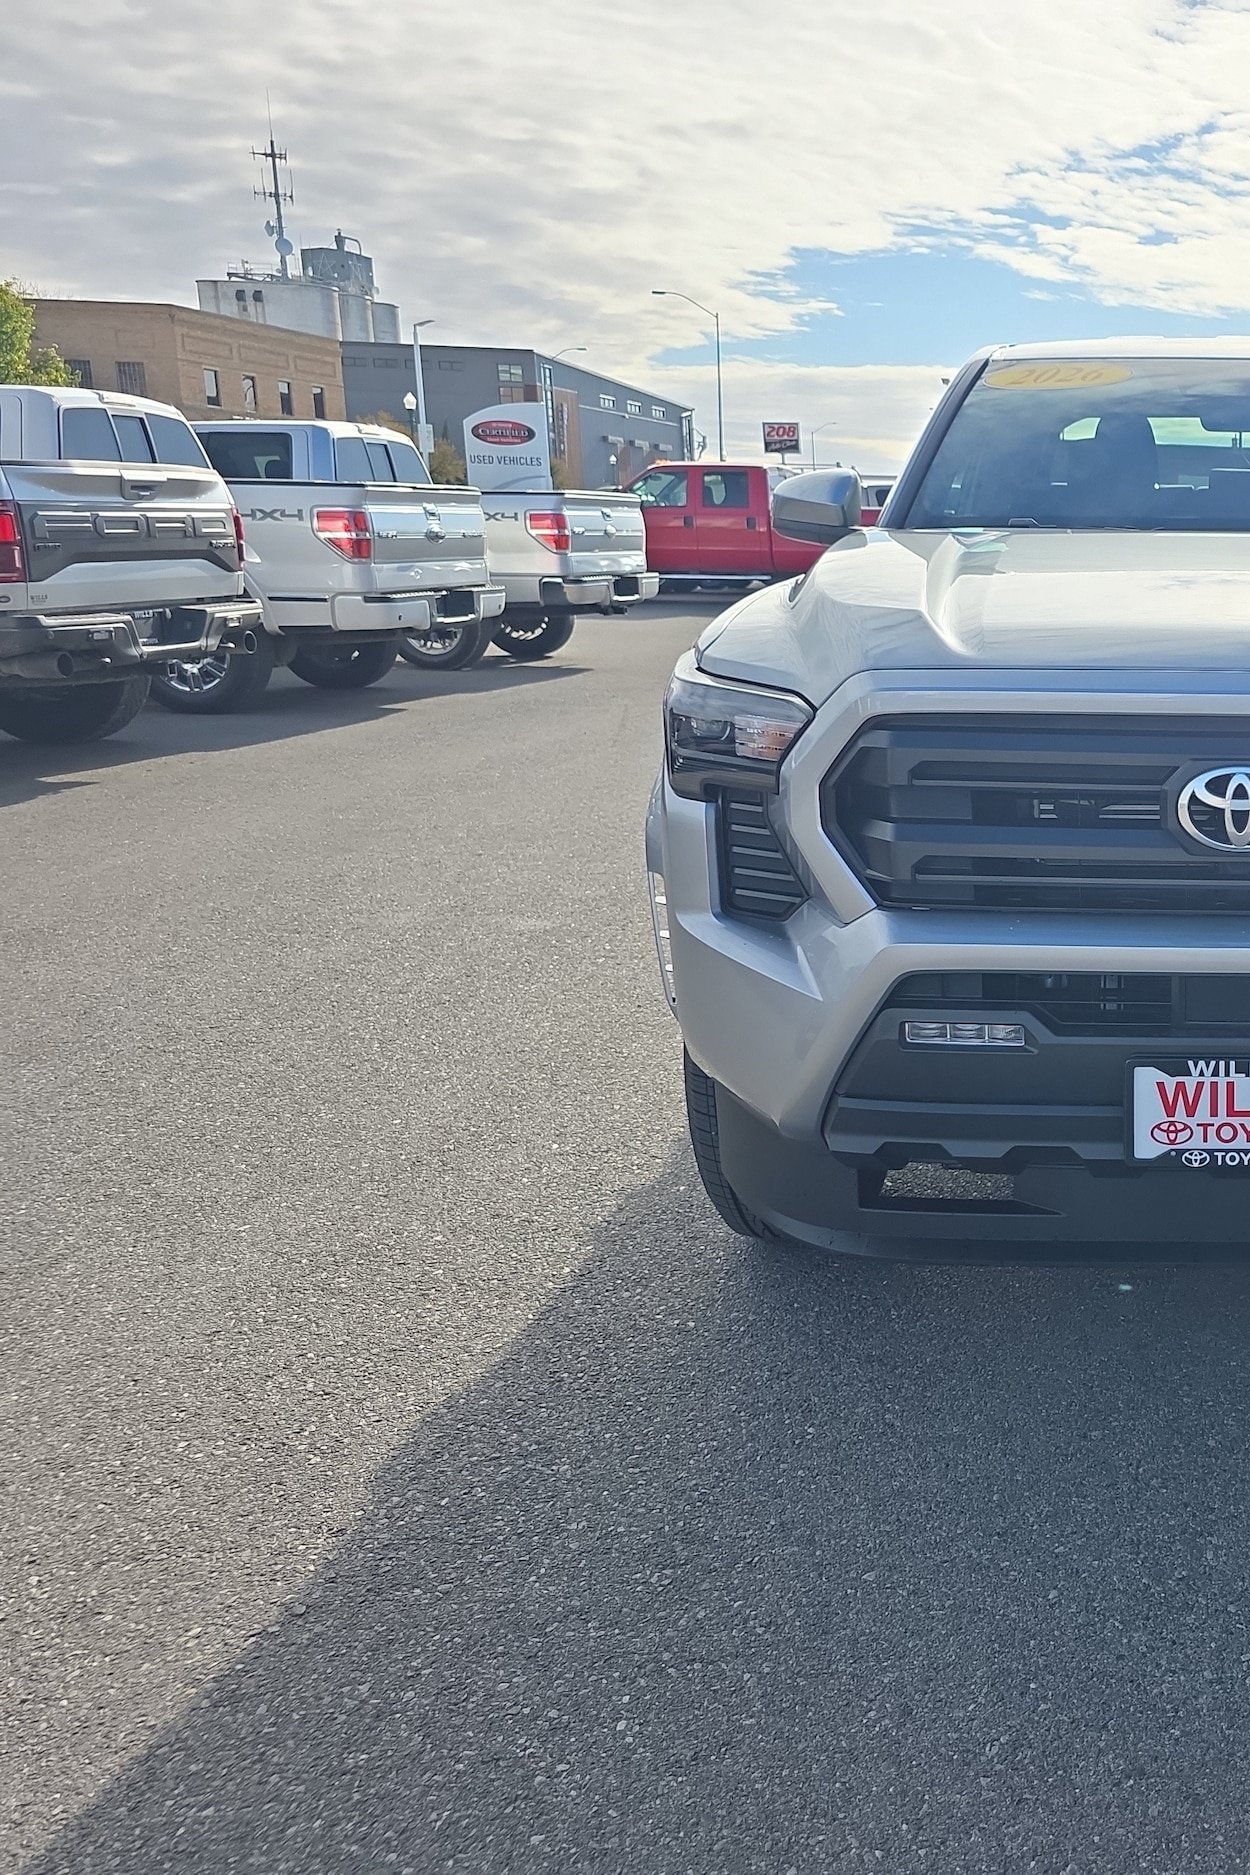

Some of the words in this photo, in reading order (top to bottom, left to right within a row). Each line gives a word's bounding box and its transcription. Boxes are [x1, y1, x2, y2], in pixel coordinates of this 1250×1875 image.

[767, 426, 796, 438] 208
[469, 454, 494, 465] USED
[497, 455, 542, 467] VEHICLES
[483, 512, 519, 522] X4
[32, 511, 230, 540] FORD
